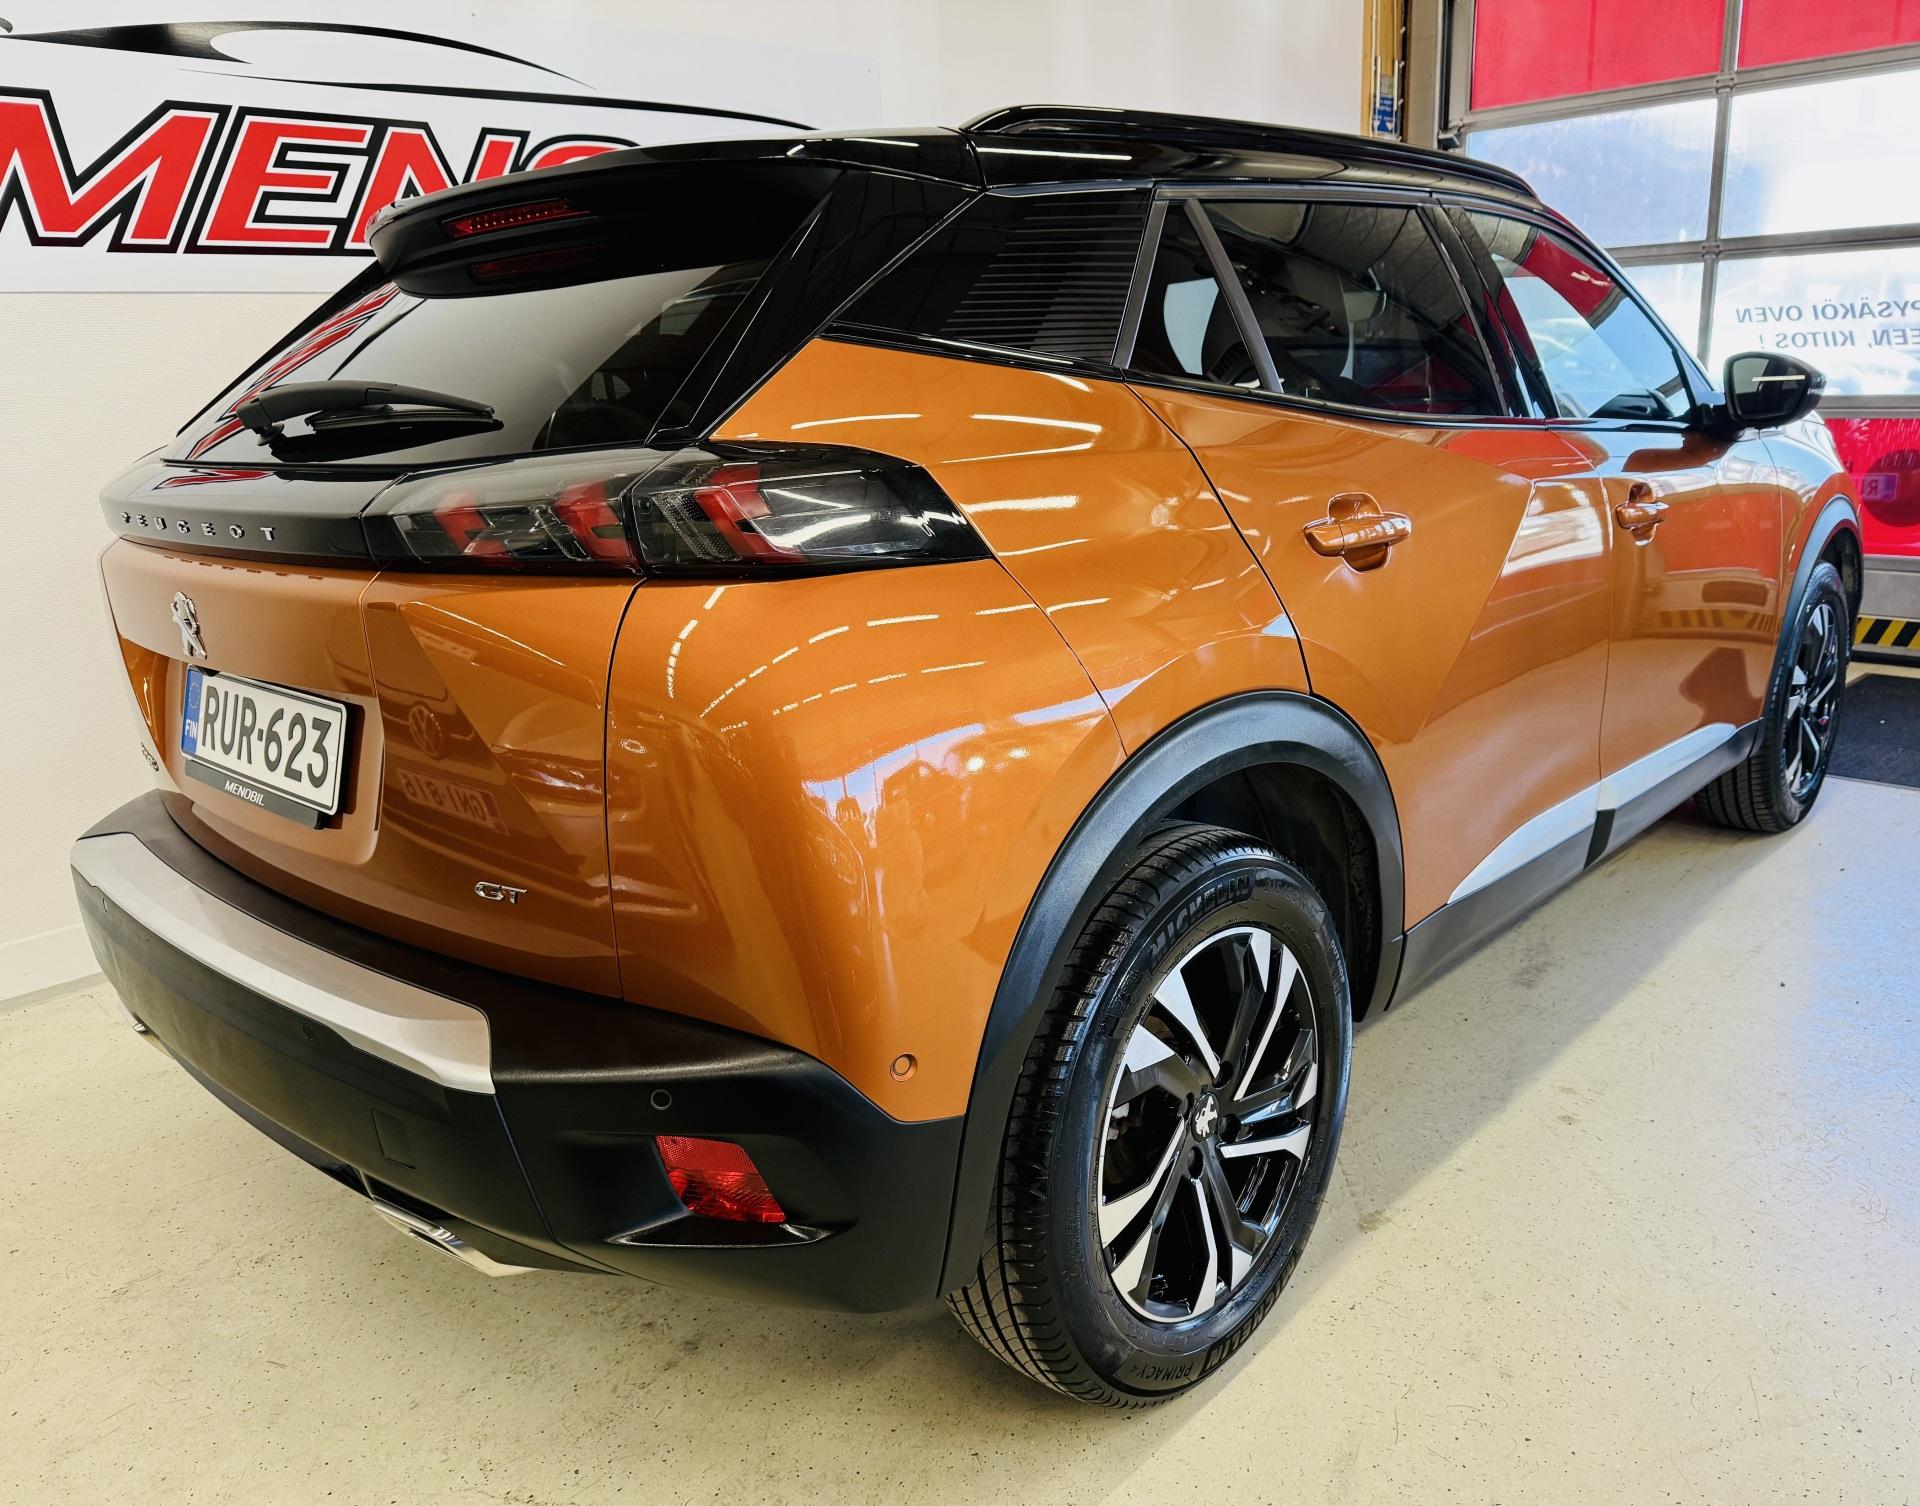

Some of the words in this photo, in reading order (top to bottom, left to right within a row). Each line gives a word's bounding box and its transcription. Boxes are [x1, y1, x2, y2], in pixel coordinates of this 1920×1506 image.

[120, 511, 276, 541] PEUGEOT
[185, 719, 198, 740] FIN
[201, 685, 332, 789] RUR-623
[224, 780, 265, 806] MENOBIL
[474, 881, 528, 904] GT
[1147, 873, 1251, 963] MICHELIN
[1136, 1362, 1194, 1381] PRIMACY
